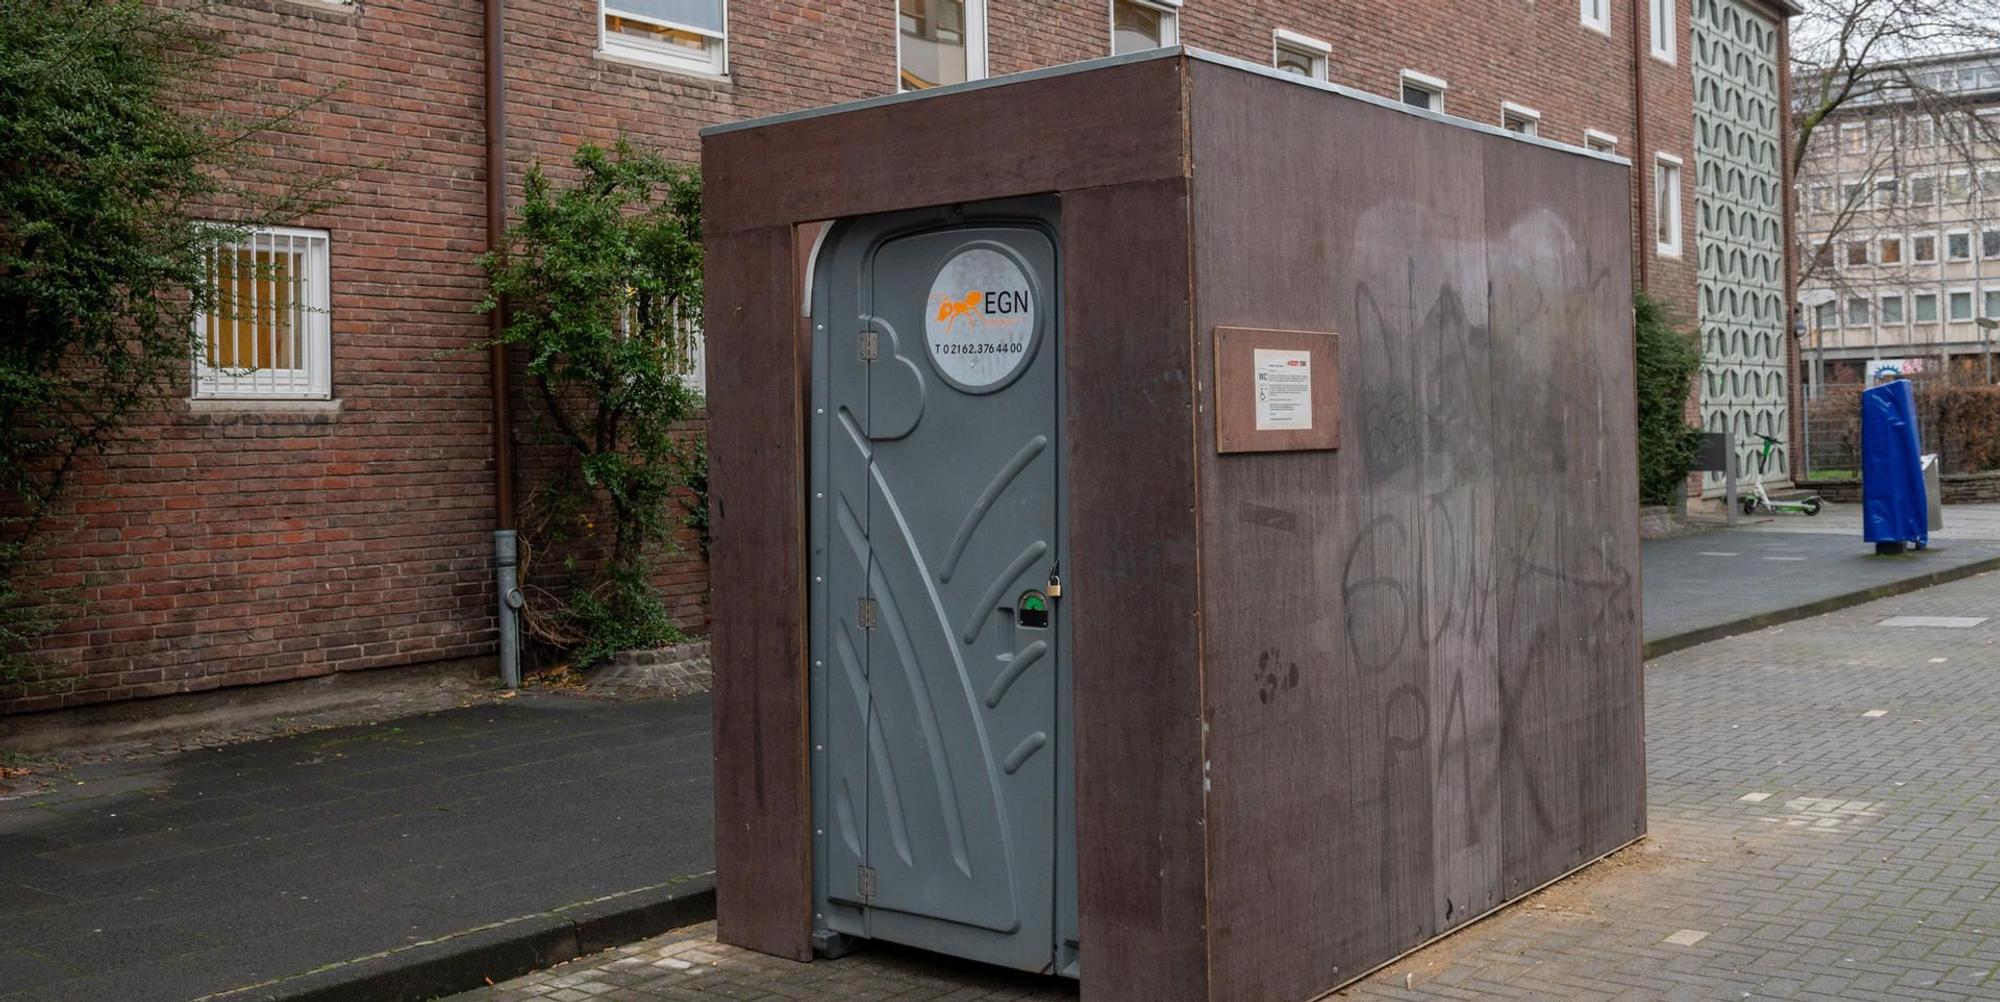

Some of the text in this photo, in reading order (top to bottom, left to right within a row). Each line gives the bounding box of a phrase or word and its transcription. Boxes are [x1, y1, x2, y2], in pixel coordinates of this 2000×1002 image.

[985, 290, 1028, 314] EGN
[935, 344, 941, 354] T
[1259, 372, 1268, 381] WC
